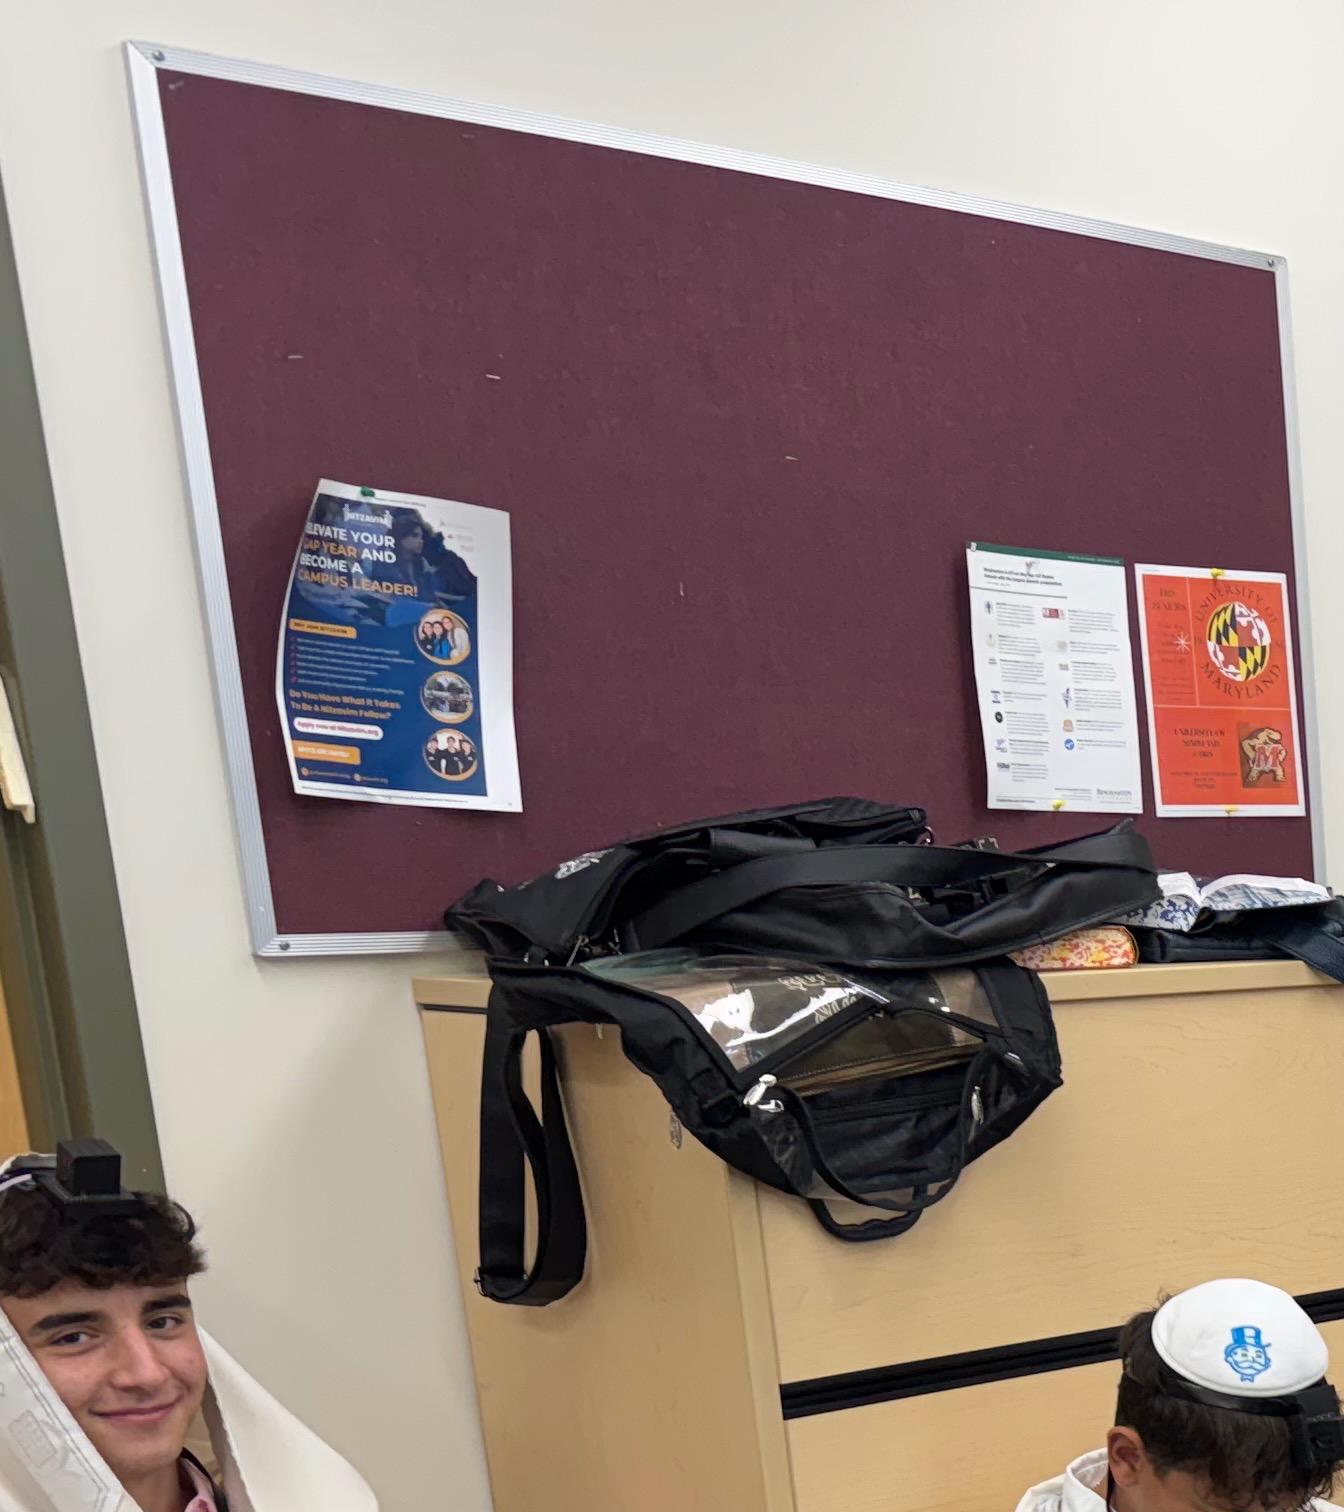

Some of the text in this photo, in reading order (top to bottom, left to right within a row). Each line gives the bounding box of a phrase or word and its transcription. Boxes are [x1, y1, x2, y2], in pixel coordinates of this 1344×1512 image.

[350, 531, 395, 548] YOUR
[323, 542, 357, 558] YEAR
[361, 548, 396, 563] AND
[300, 553, 363, 574] BECOME A
[298, 568, 418, 597] CAMPUS LEADER!
[1255, 745, 1281, 770] M
